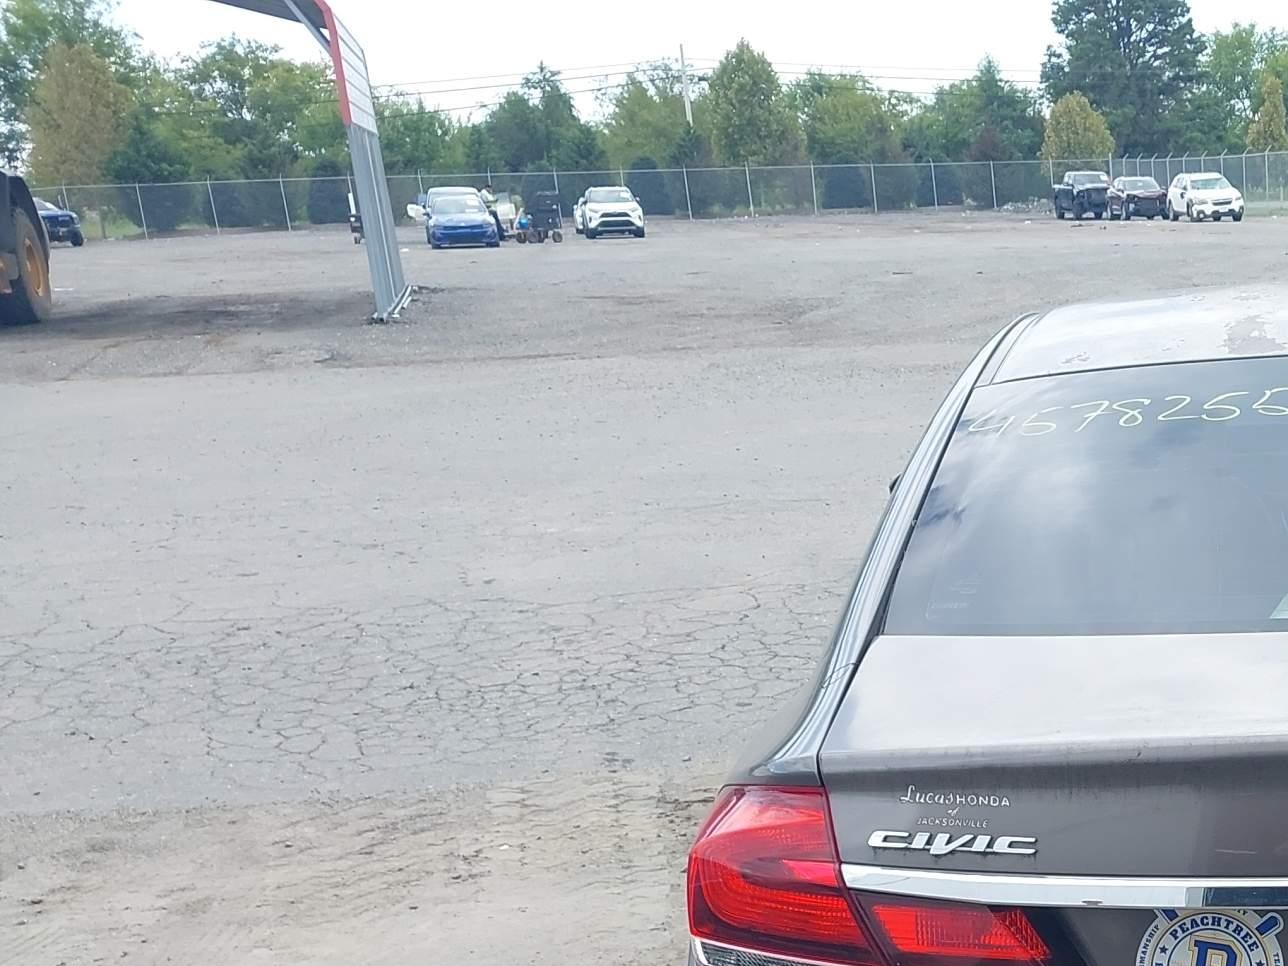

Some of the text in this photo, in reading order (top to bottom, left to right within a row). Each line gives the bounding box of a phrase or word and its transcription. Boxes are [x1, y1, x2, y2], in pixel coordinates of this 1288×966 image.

[916, 817, 989, 828] JACKSONVILLE
[867, 830, 1038, 855] CIVIC
[1169, 915, 1260, 953] PEACHTREE
